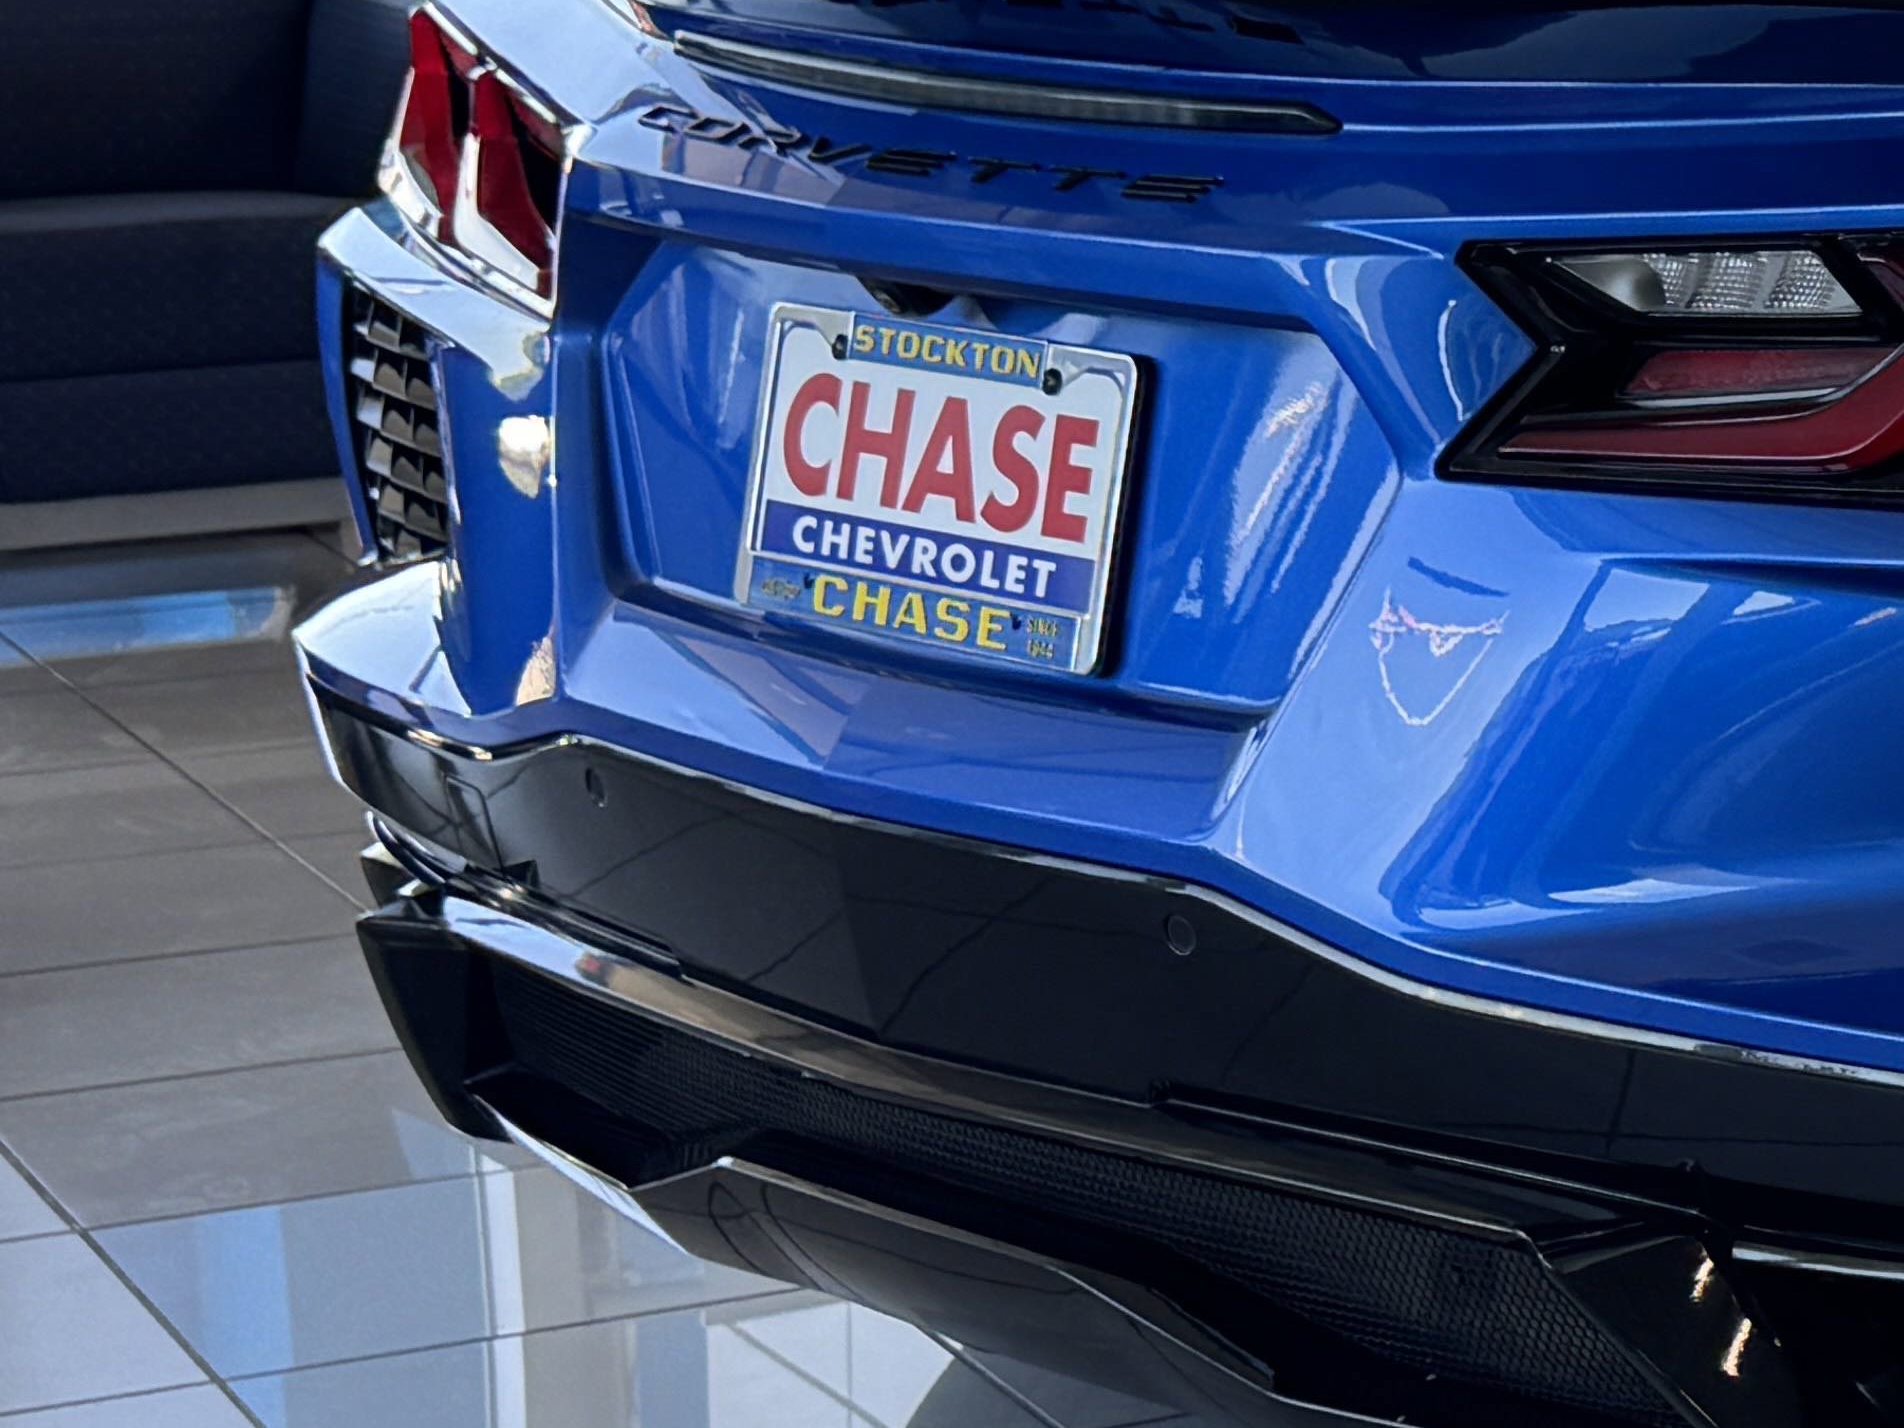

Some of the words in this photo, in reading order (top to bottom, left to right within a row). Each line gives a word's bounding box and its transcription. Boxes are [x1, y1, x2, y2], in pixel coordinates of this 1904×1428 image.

[636, 102, 1224, 204] CORVETTE
[852, 324, 1042, 380] STOCKTON
[783, 372, 1100, 544] CHASE
[792, 514, 1057, 599] CHEVROLET
[812, 573, 1012, 652] CHASE
